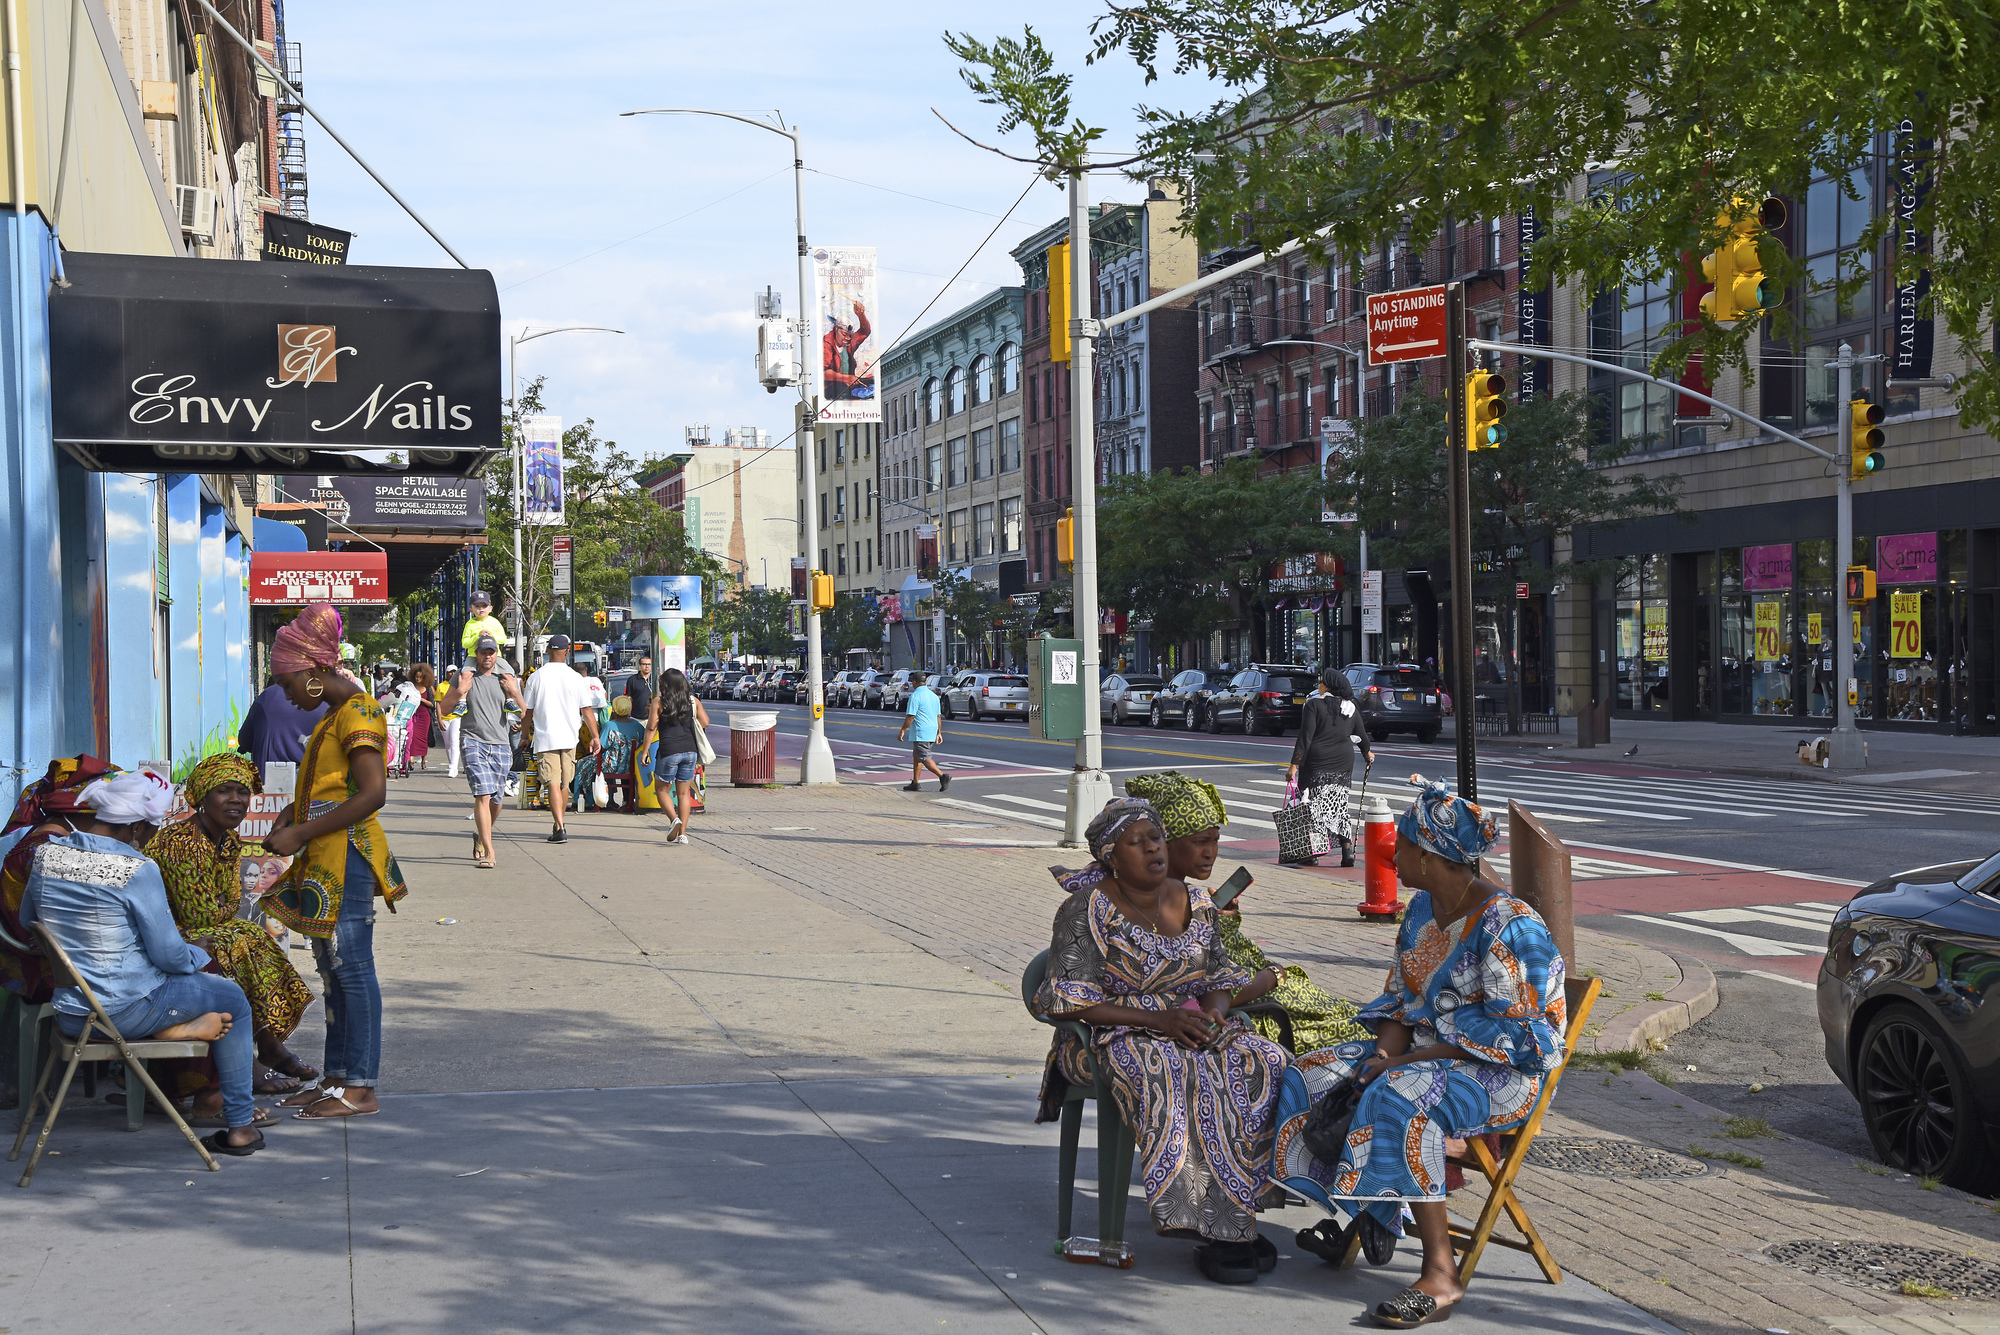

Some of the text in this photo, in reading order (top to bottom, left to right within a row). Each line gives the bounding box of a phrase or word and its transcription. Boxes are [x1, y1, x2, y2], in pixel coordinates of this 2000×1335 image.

[818, 268, 839, 276] Music
[847, 268, 874, 276] Fashion
[828, 276, 864, 285] EXPLOSION
[1373, 293, 1445, 315] NO STANDING
[1374, 315, 1418, 333] Anytime
[129, 373, 473, 432] Envy Nails
[402, 477, 438, 486] RETAIL
[375, 486, 467, 498] SPACE AVAILABLE
[1880, 538, 1937, 570] Karma
[1744, 548, 1792, 578] Karma
[277, 571, 363, 579] HOTSEXYFIT
[1894, 602, 1917, 613] SALE
[1648, 614, 1663, 623] SALE
[1757, 610, 1776, 620] SALE
[1810, 623, 1819, 639] 50
[1893, 620, 1919, 652] 70
[1756, 627, 1778, 656] 70
